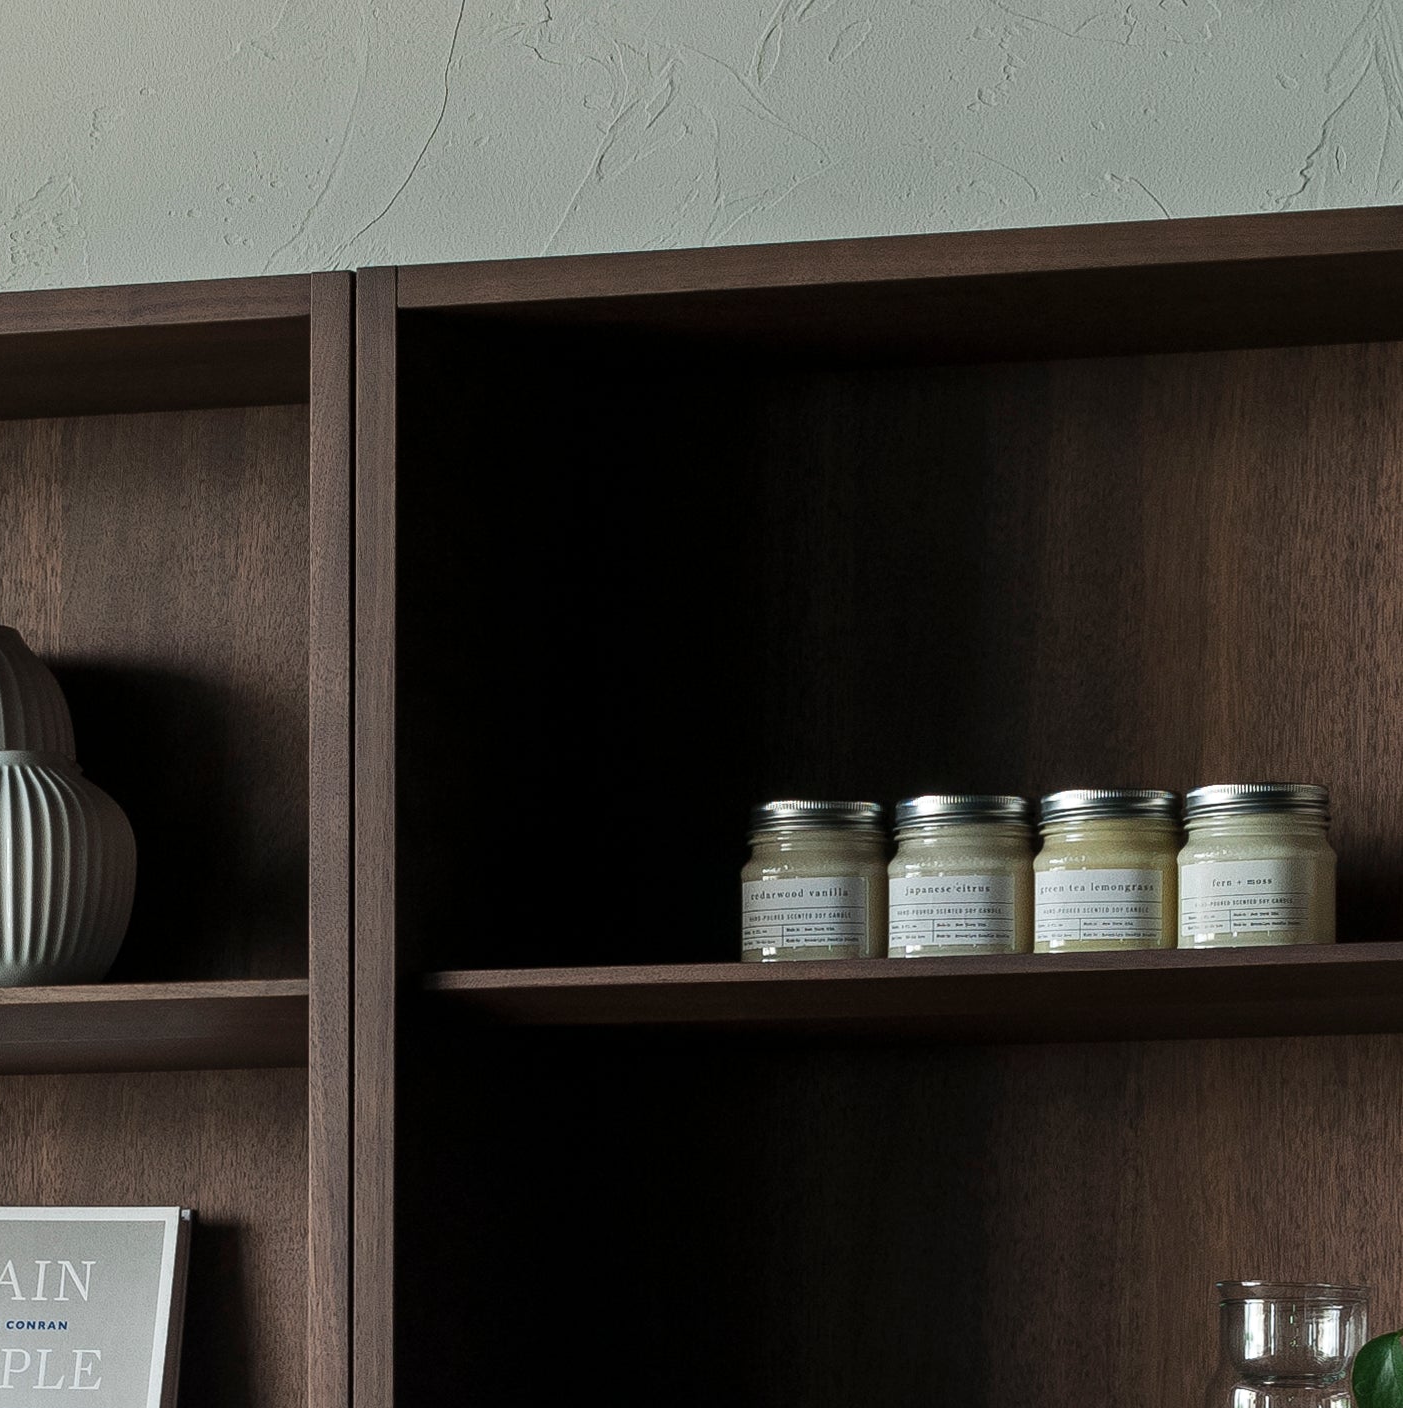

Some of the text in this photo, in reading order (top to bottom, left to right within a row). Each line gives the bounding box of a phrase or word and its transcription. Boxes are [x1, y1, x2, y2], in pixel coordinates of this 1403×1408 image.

[1040, 886, 1064, 894] green
[1091, 882, 1154, 893] lemongrass
[1212, 879, 1232, 887] fern
[750, 888, 849, 900] cedarwood vanilla
[905, 884, 991, 896] japanese citrus
[6, 1320, 69, 1331] CONRAN
